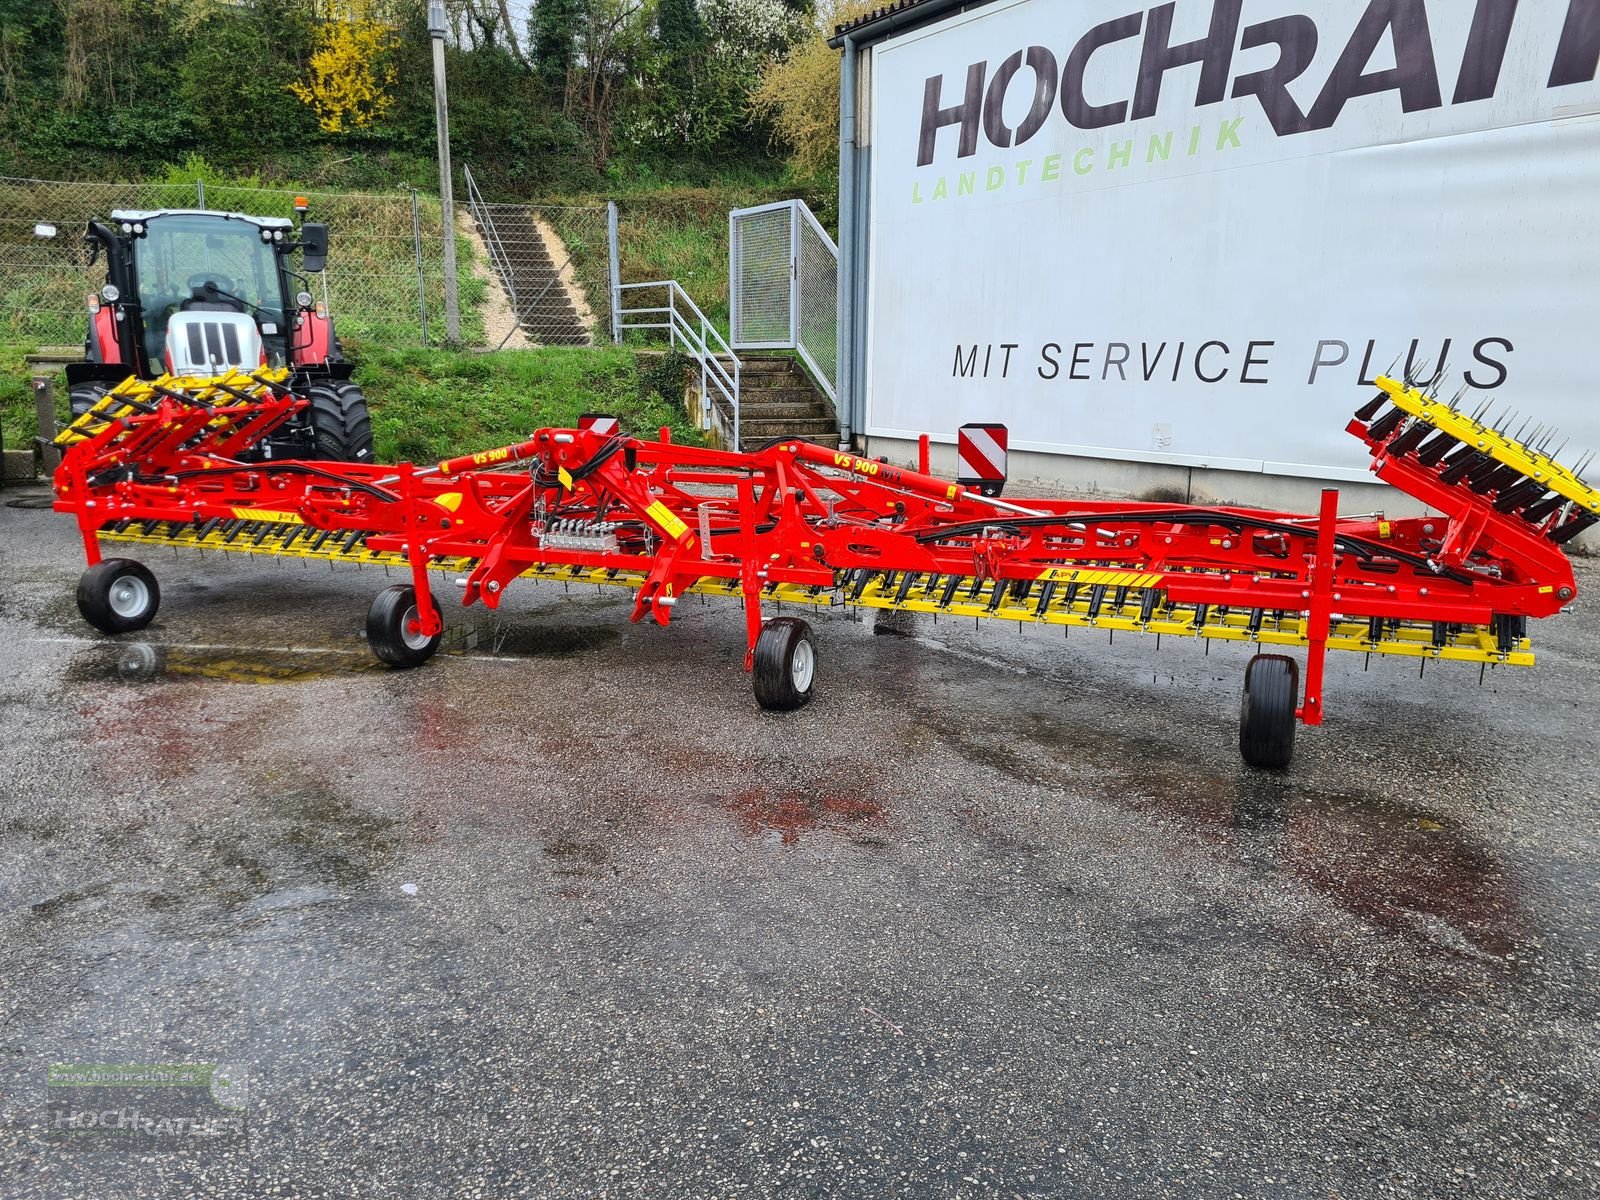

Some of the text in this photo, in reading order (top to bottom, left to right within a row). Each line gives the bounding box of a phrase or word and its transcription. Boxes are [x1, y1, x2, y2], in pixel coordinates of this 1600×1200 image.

[911, 117, 1245, 204] LANDTECHNIK
[952, 337, 1514, 389] MIT SERVICE PLUS
[473, 453, 487, 465] VS
[488, 448, 507, 461] 900
[834, 453, 852, 468] VS
[854, 459, 879, 475] 900
